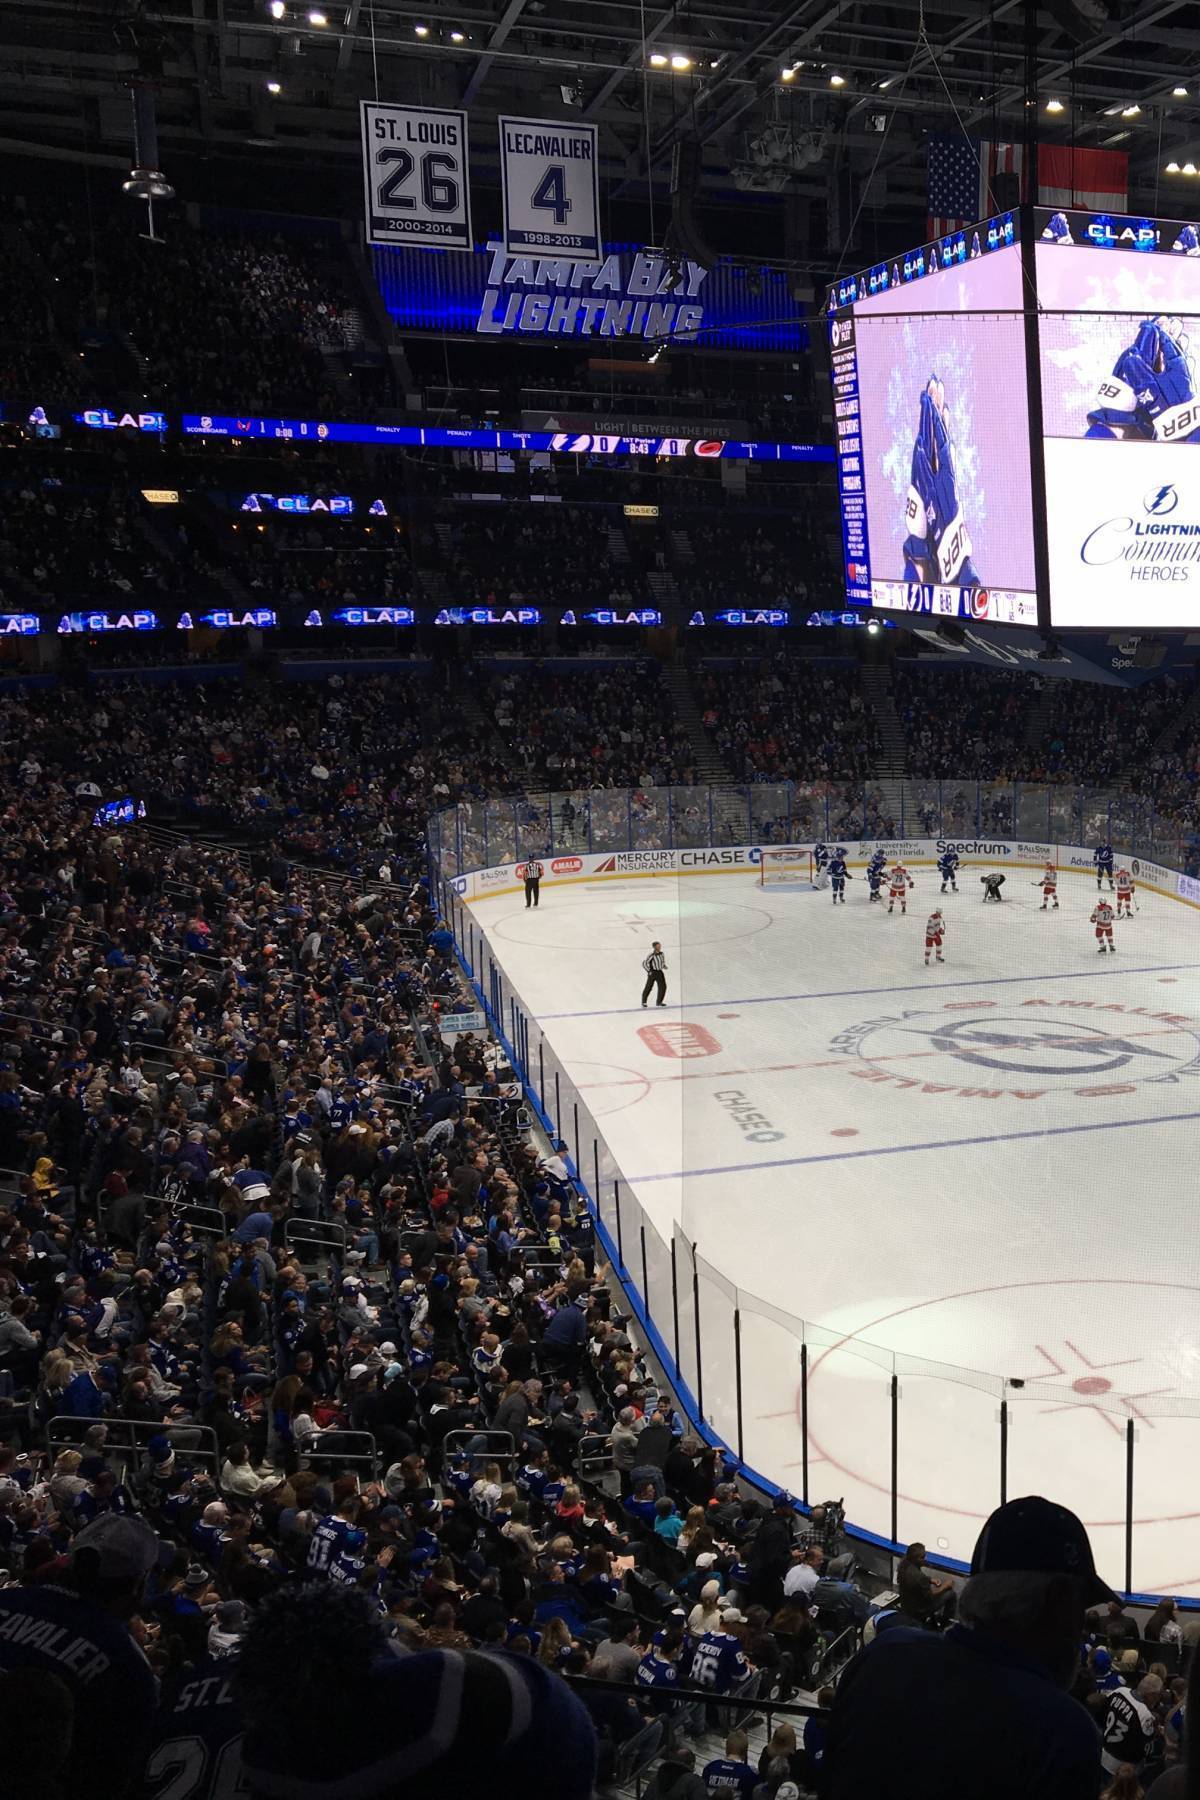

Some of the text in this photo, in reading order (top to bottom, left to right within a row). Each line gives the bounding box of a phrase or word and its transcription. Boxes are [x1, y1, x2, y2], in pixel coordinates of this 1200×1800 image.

[375, 118, 458, 146] ST. LOUIS
[507, 132, 592, 160] LECAVALIER
[376, 146, 460, 213] 26
[531, 164, 572, 225] 4
[388, 220, 452, 234] 2000-2014
[988, 222, 1013, 243] CLAP!
[1088, 224, 1161, 244] CLAP!
[524, 232, 582, 246] 1998-2013
[943, 240, 966, 260] CLAP!
[904, 257, 924, 275] CLAP!
[476, 289, 704, 341] LIGHTNING
[83, 410, 164, 430] CLAP!
[186, 426, 228, 434] SCOREBOARD
[594, 421, 624, 433] LIGHT
[632, 423, 676, 434] BETWEEN
[679, 425, 700, 436] THE
[703, 427, 730, 437] PIPES
[600, 438, 609, 451] 0
[629, 443, 650, 454] 8:43
[670, 440, 678, 454] 0
[277, 497, 353, 512] CLAP!
[624, 507, 651, 515] CHASE
[1130, 566, 1189, 581] HEROES
[89, 614, 155, 629] CLAP!
[212, 611, 277, 626] CLAP!
[347, 610, 415, 625] CLAP!
[472, 610, 539, 624] CLAP!
[597, 610, 661, 624] CLAP!
[727, 611, 788, 625] CLAP!
[0, 618, 40, 632] LAP!
[936, 841, 1006, 856] Spectrum
[617, 852, 676, 863] MERCURY
[681, 850, 745, 866] CHASE
[553, 861, 581, 870] AMALIE
[618, 861, 676, 871] INSURANCE
[1021, 999, 1192, 1025] AMALIE
[713, 1089, 773, 1130] CHASE
[307, 1536, 332, 1571] 91
[1110, 1696, 1134, 1722] PUPPA
[1104, 1711, 1129, 1743] 93
